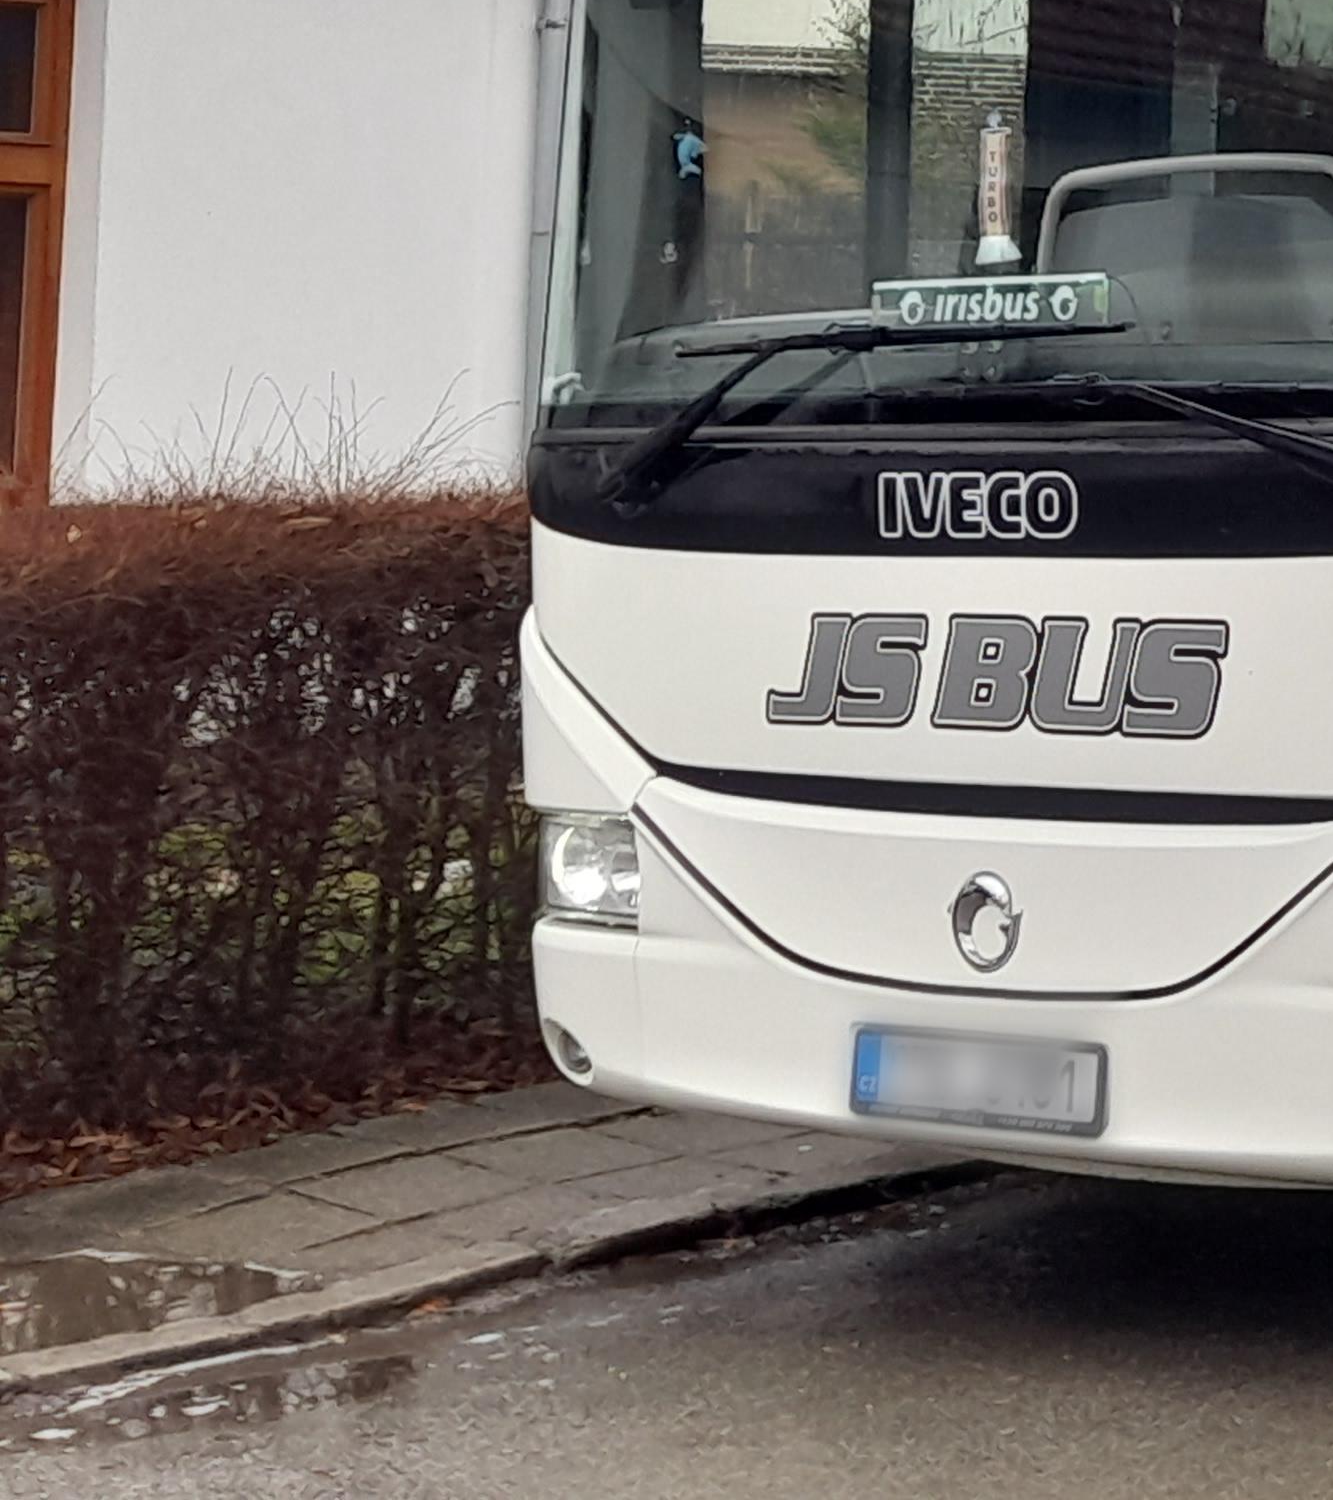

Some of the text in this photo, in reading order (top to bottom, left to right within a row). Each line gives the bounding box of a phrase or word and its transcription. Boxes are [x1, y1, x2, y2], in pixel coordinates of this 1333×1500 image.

[987, 151, 999, 224] TURBO
[933, 287, 1041, 323] irisbus
[877, 471, 1079, 539] IVECO
[766, 611, 1230, 739] JS BUS
[859, 1075, 877, 1093] CZ
